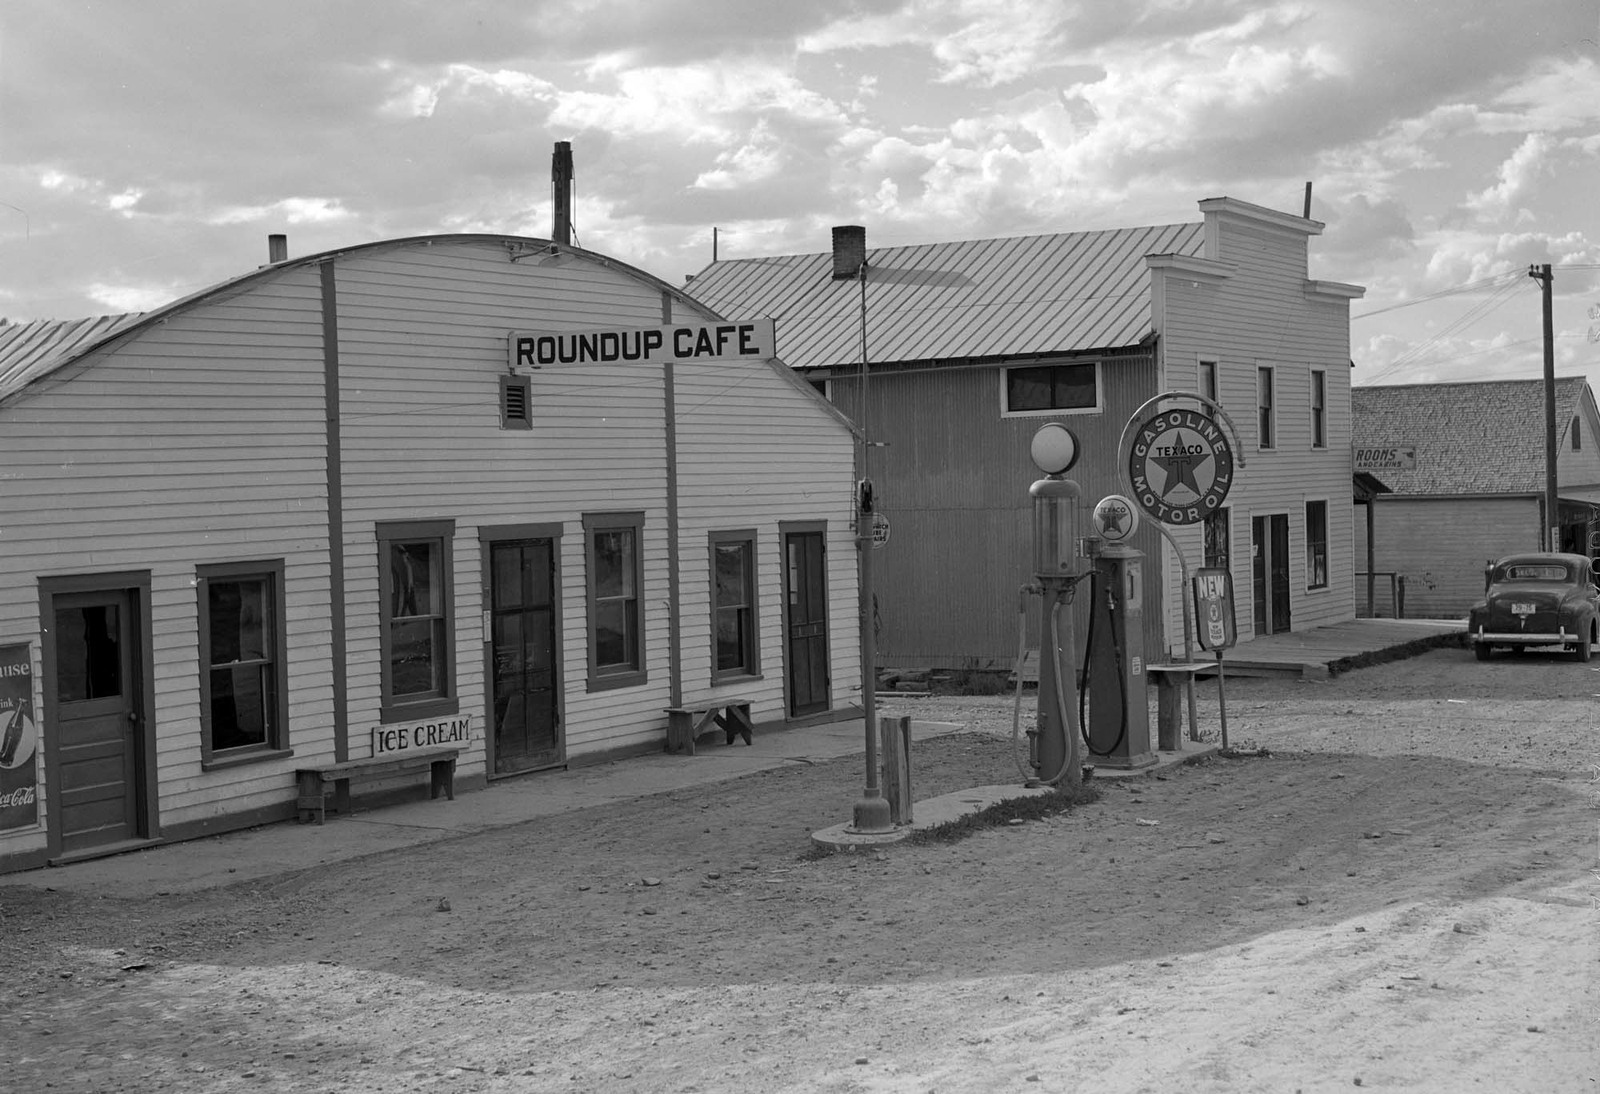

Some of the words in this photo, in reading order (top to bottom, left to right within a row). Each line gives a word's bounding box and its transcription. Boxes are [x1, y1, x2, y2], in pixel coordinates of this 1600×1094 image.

[517, 330, 663, 365] ROUNDUP
[673, 325, 760, 358] CAFE
[1135, 413, 1226, 457] GASOLINE
[1156, 444, 1203, 456] TEXACO
[1356, 449, 1398, 461] ROOMS
[1134, 475, 1200, 522] MOTOR
[1205, 473, 1229, 508] OIL
[1199, 575, 1224, 598] NEW
[378, 729, 409, 753] ICE
[414, 719, 470, 747] CREAM
